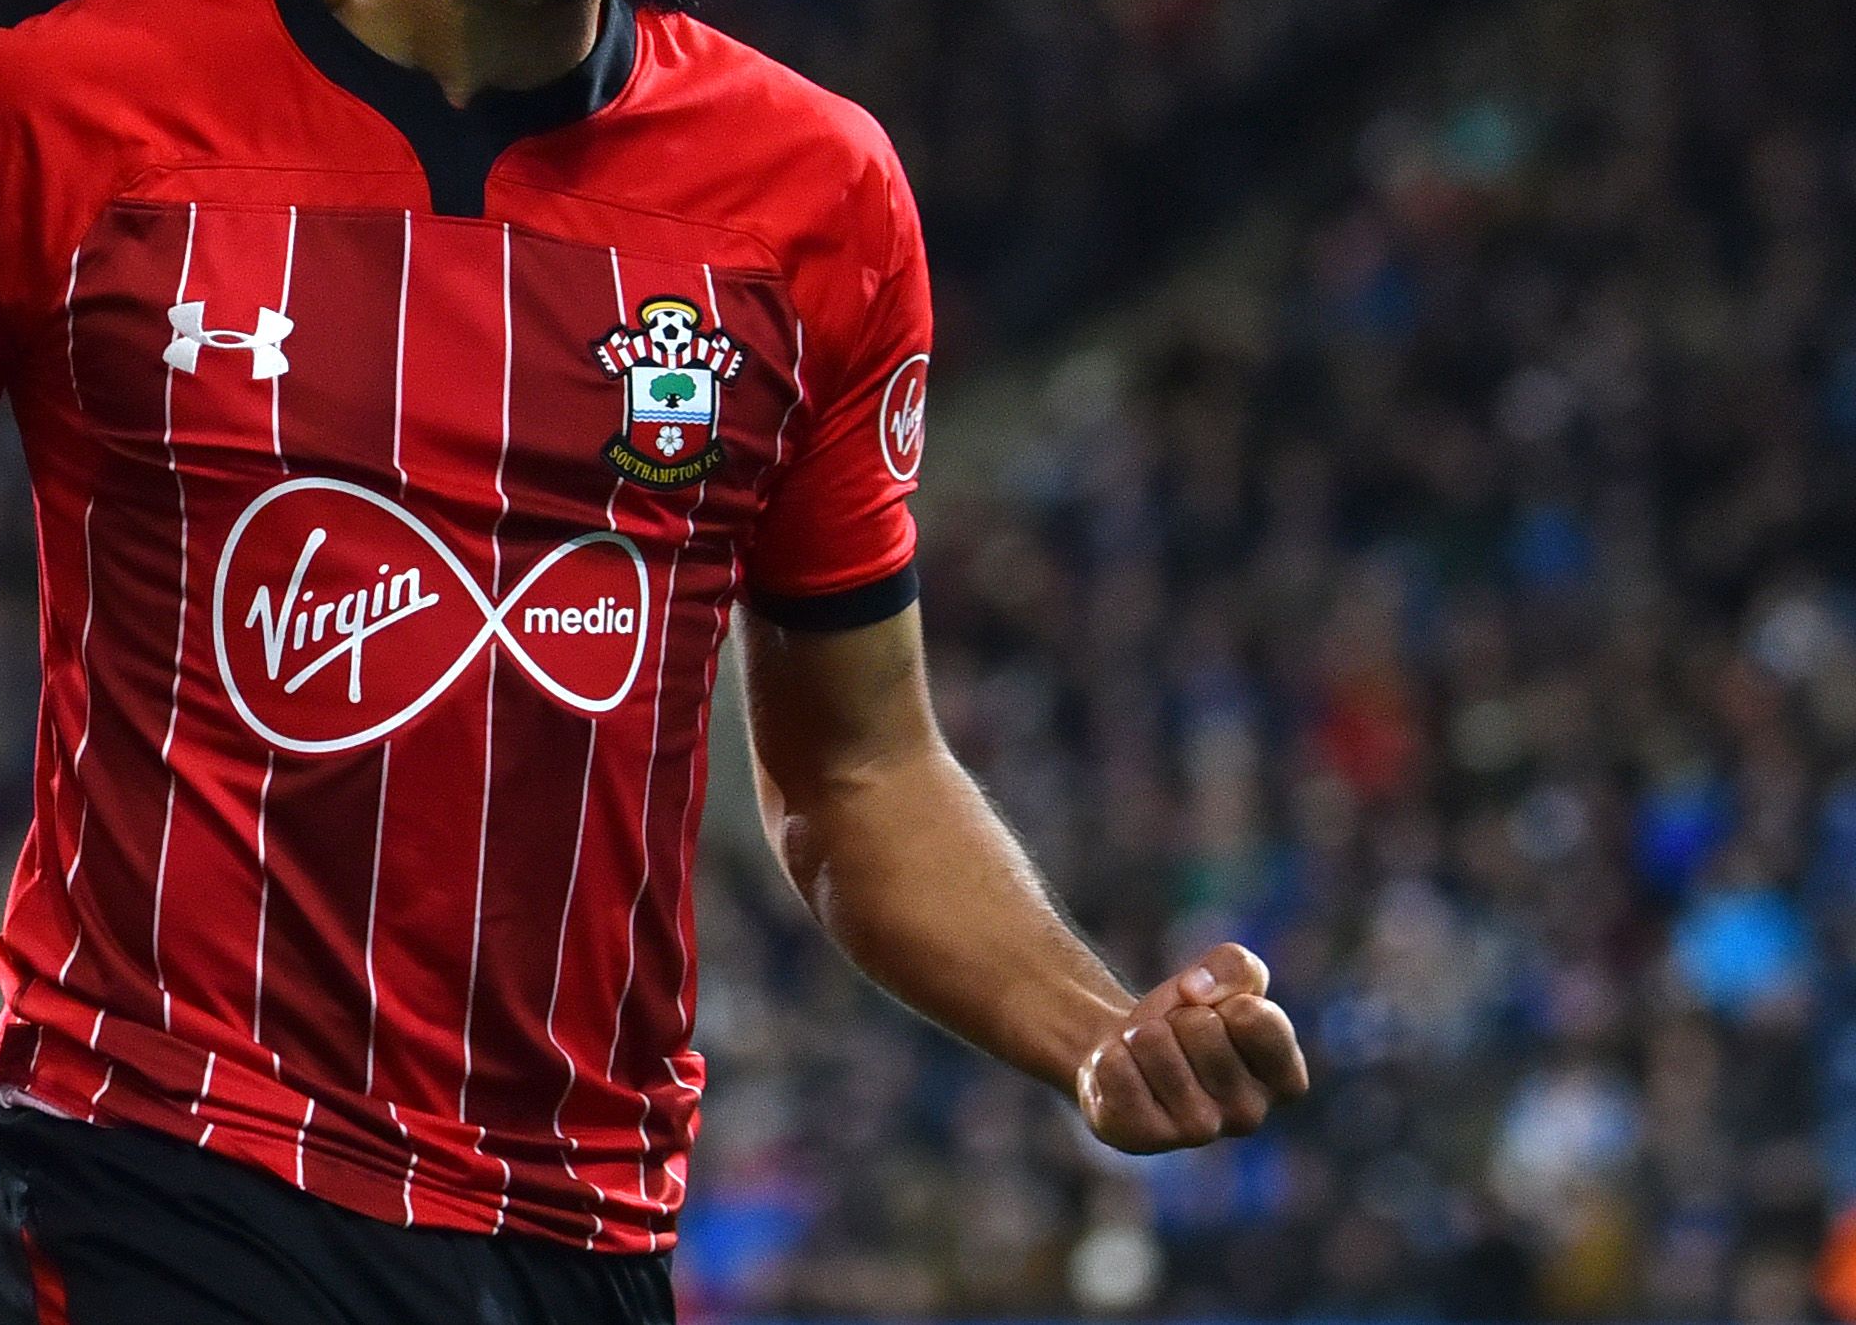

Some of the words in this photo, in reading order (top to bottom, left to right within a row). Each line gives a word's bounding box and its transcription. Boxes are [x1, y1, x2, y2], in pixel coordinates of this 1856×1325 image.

[609, 444, 702, 483] SOUTHAMPTON
[706, 449, 721, 468] FC
[245, 528, 439, 703] Virgin
[524, 597, 634, 633] media
